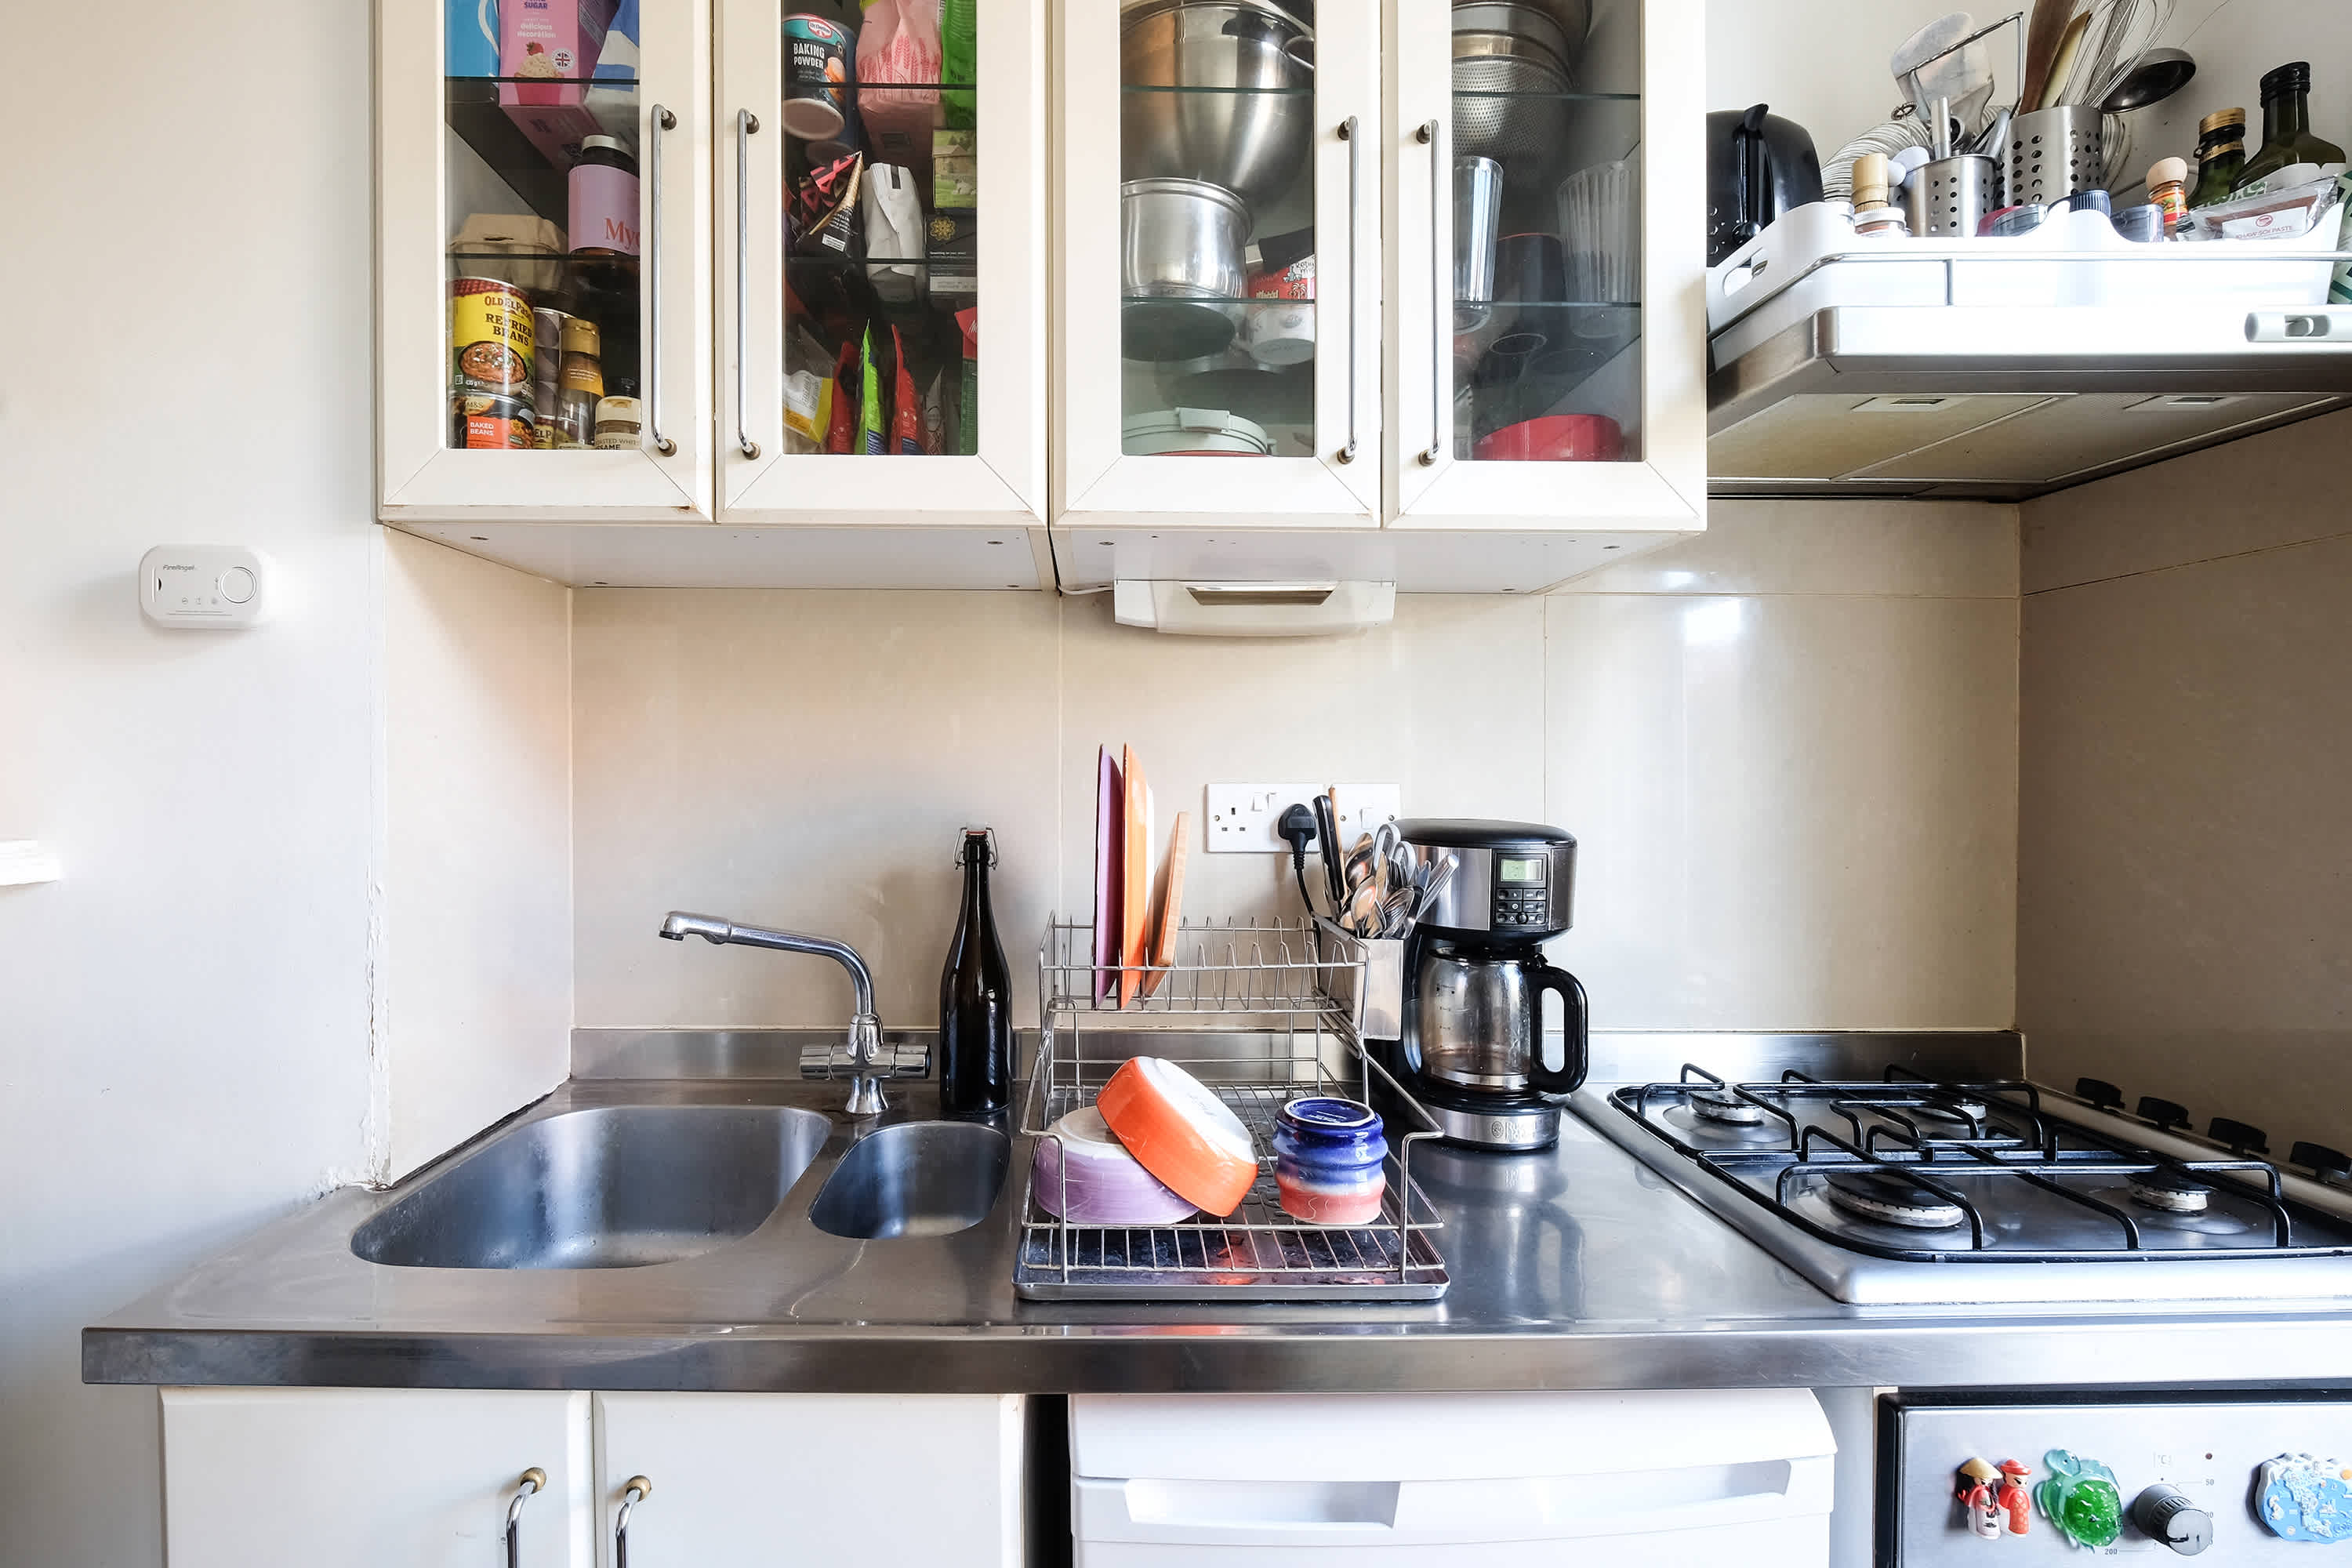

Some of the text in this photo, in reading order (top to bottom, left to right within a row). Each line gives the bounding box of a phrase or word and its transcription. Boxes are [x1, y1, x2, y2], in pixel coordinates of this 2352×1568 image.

[793, 42, 825, 59] BAKING
[793, 56, 824, 70] POWDER
[470, 428, 494, 437] BEANS
[2104, 1548, 2118, 1556] 200
